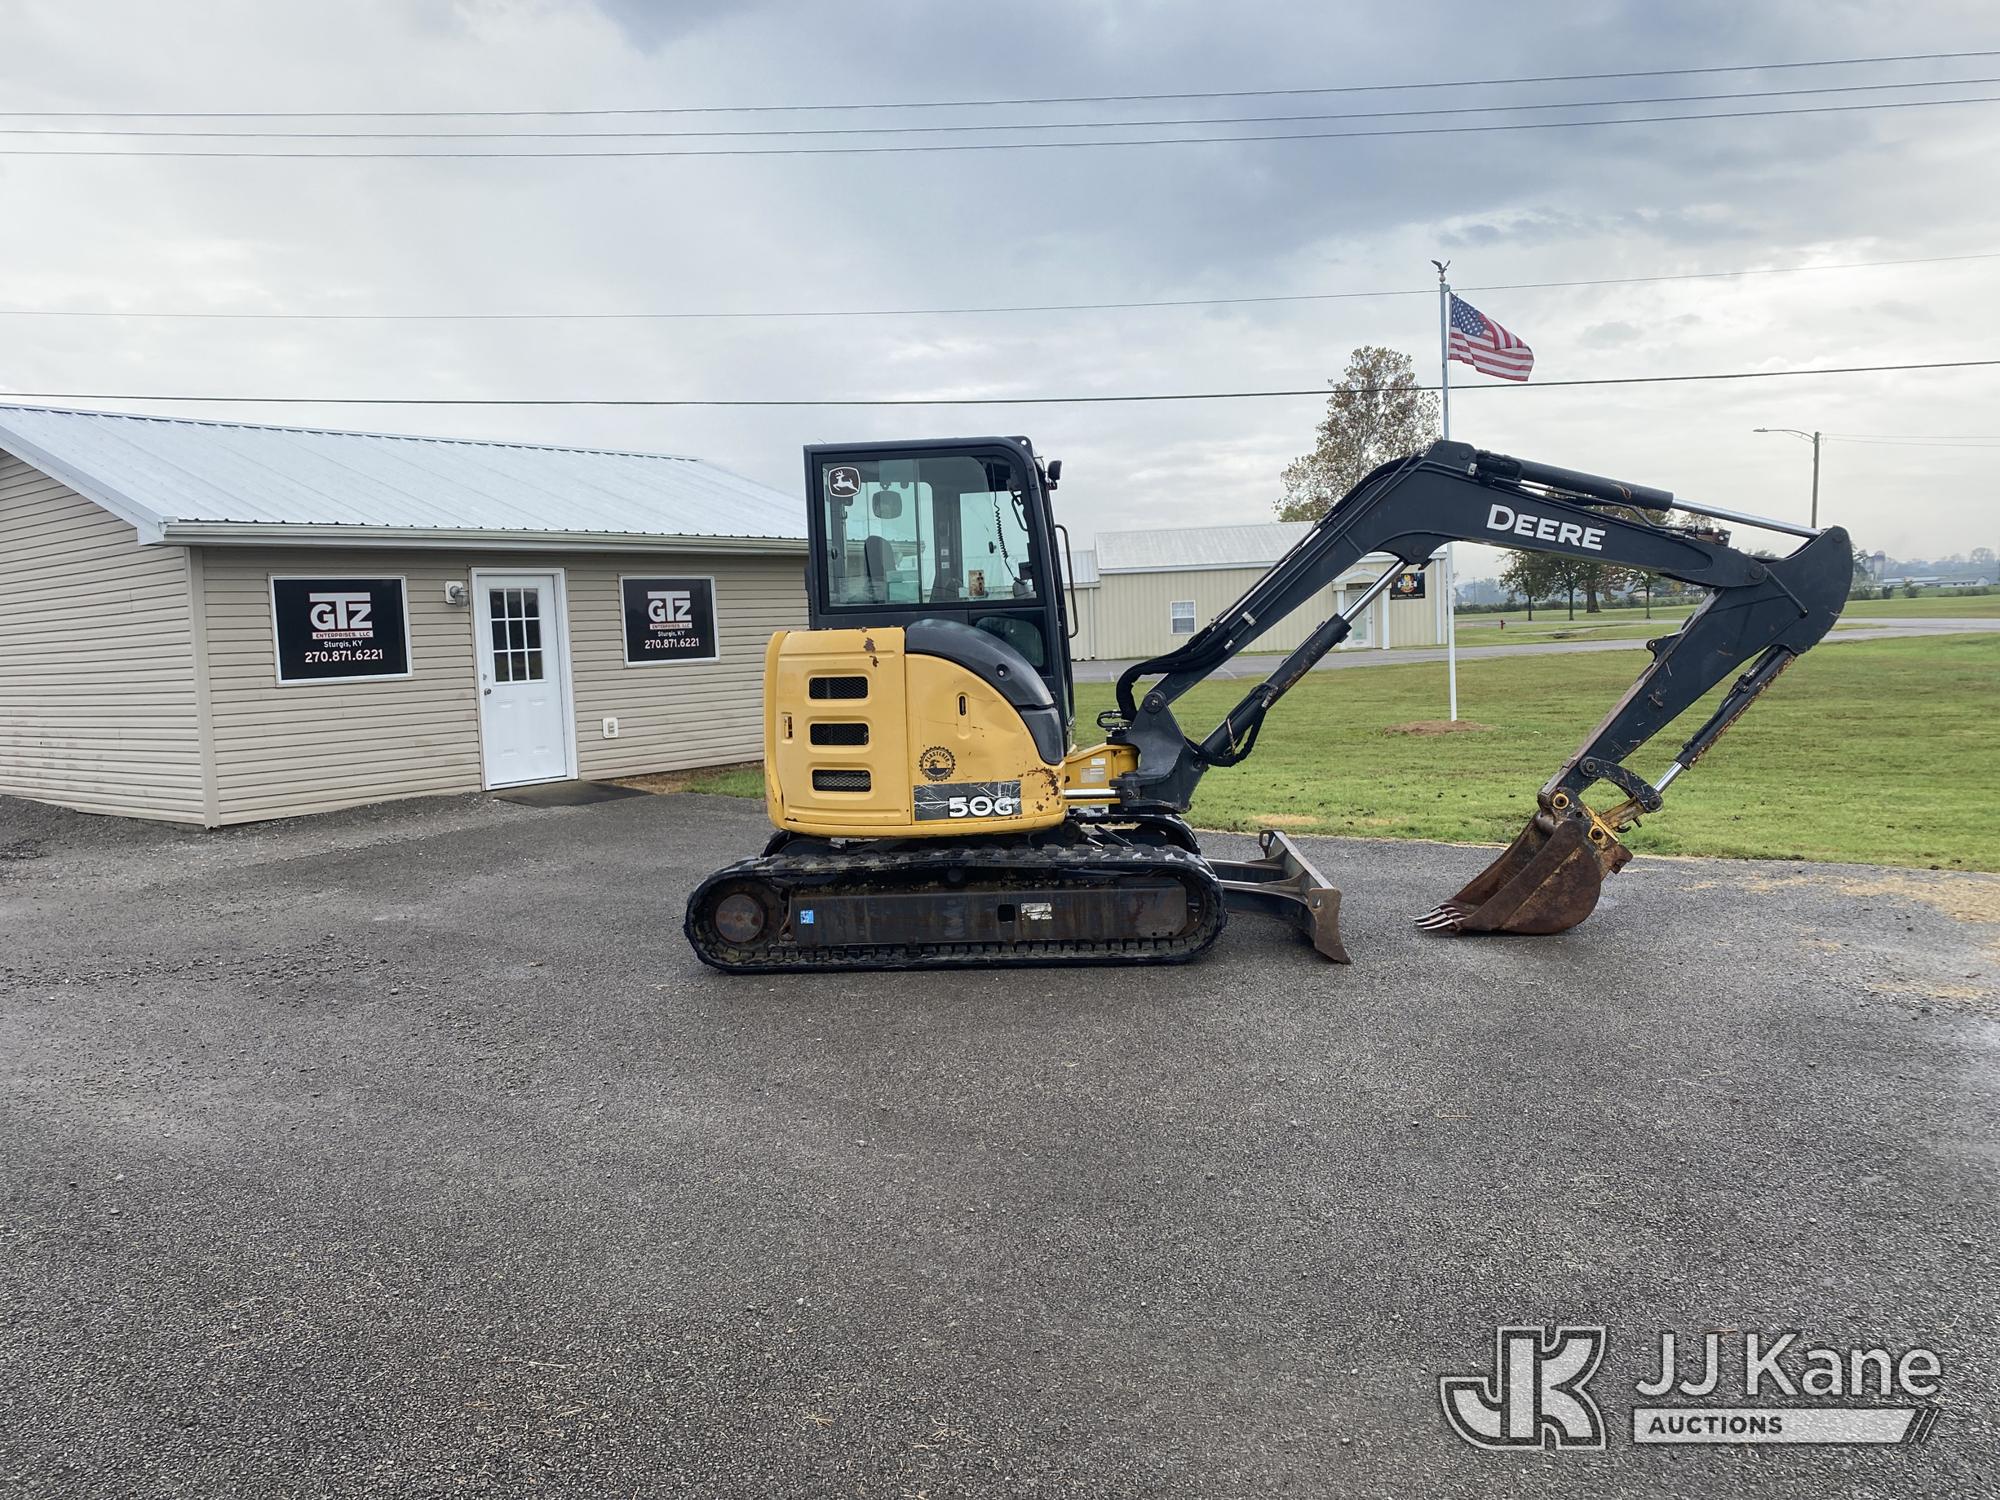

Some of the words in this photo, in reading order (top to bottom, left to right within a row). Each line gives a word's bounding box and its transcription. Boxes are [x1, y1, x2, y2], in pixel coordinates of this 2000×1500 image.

[1486, 503, 1606, 551] DEERE
[309, 592, 372, 630] GTZ
[647, 591, 692, 622] GTZ
[323, 641, 352, 649] Sturgis,
[645, 638, 699, 649] 270.871.6221
[305, 649, 383, 663] 270.871.6221
[948, 795, 1014, 818] 50G
